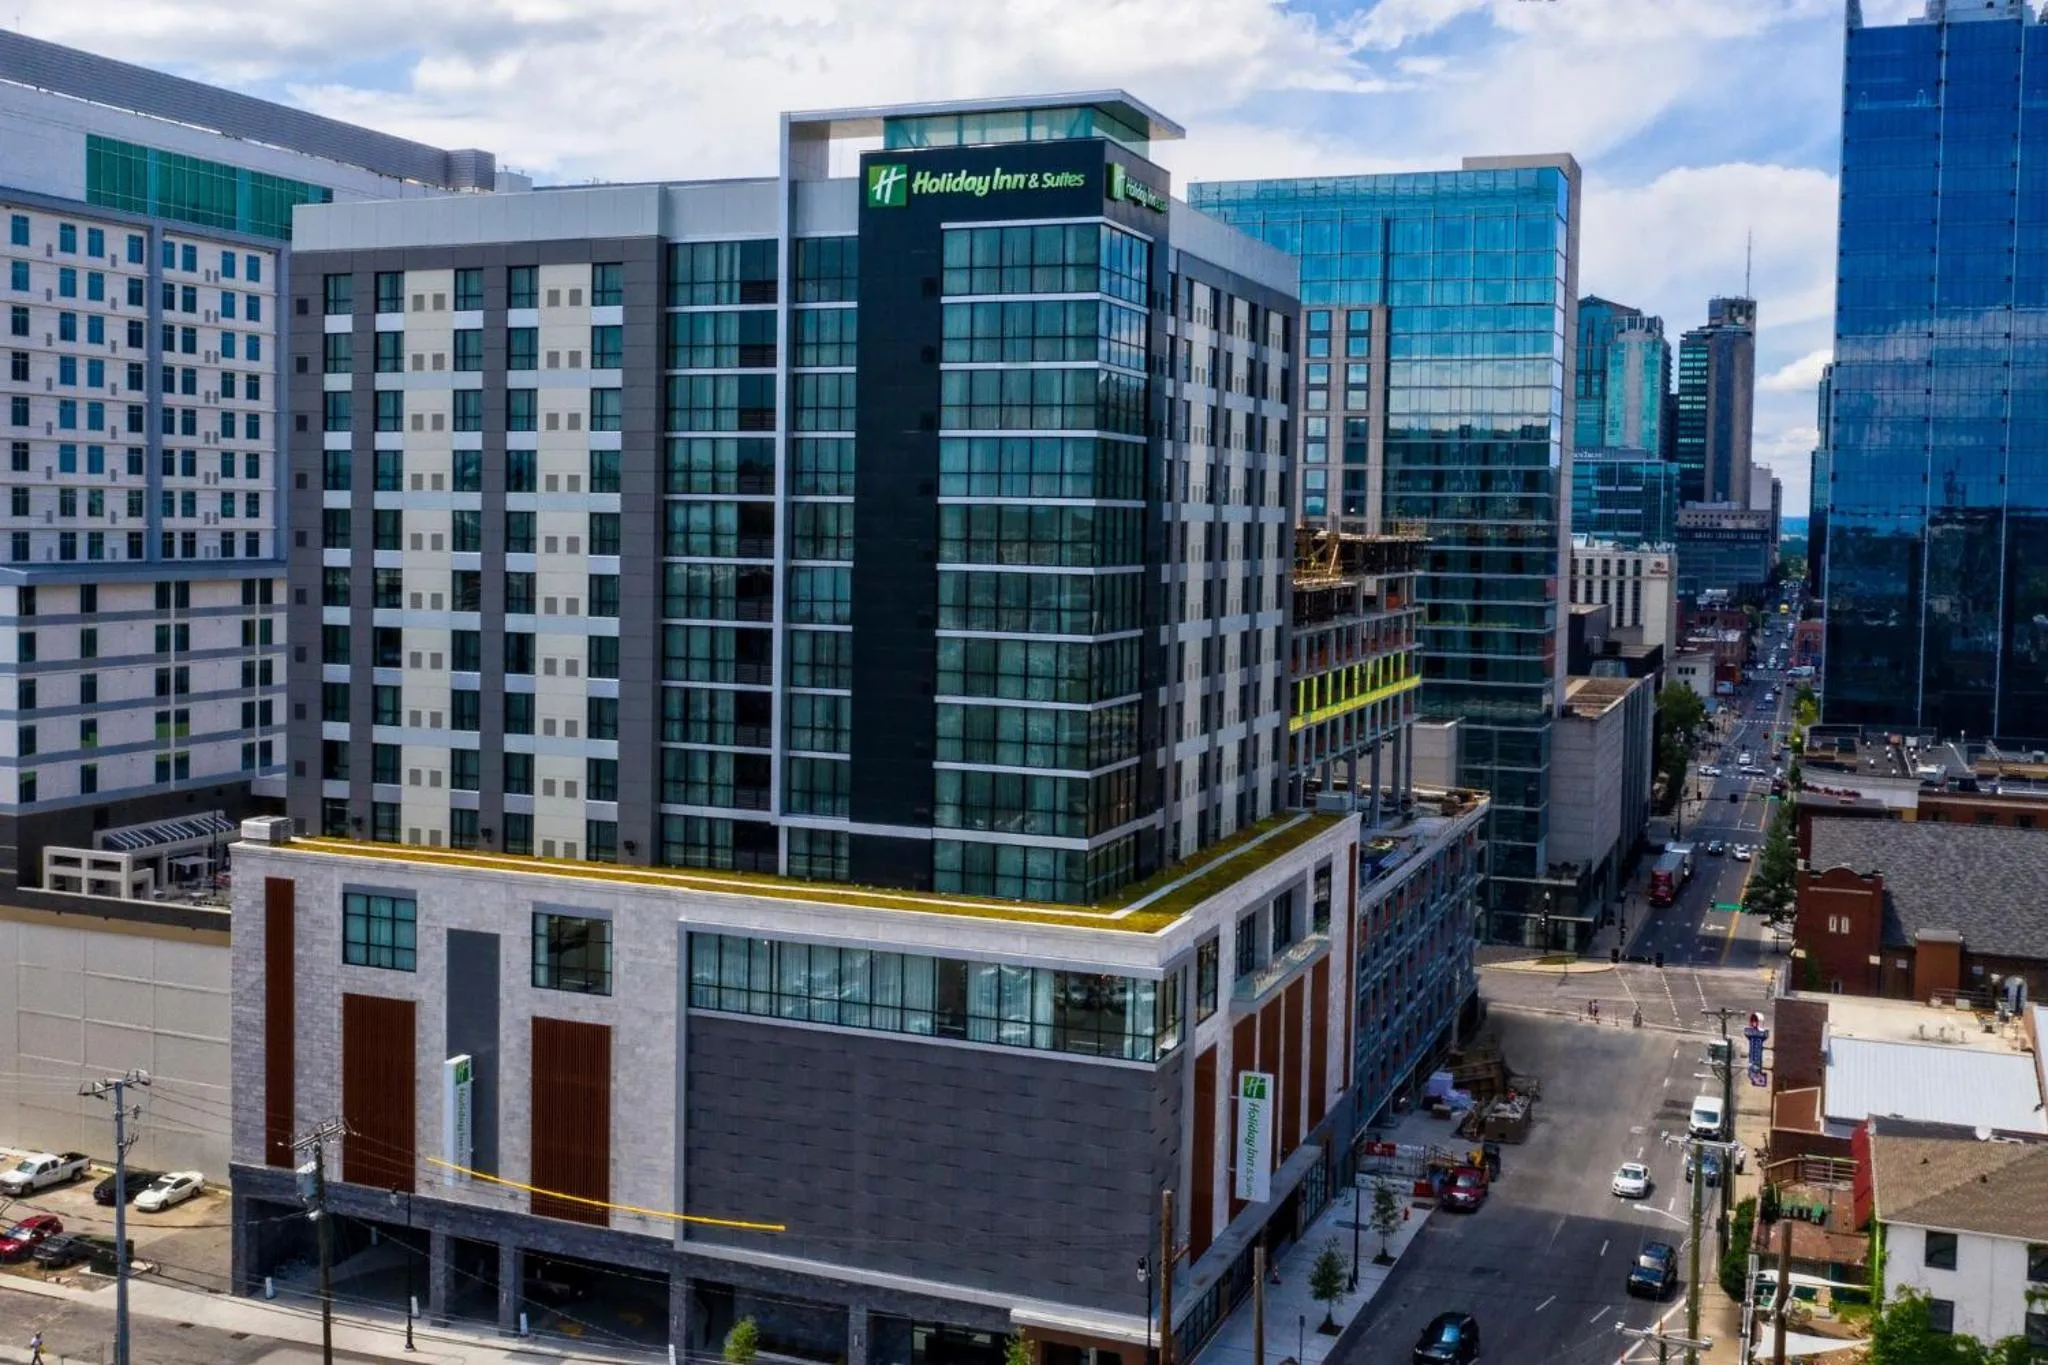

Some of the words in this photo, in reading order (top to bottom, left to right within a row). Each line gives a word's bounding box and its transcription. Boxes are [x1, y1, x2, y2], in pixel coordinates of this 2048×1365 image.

[912, 169, 990, 196] Holiday
[992, 167, 1027, 190] Inn
[1029, 175, 1039, 188] &
[1042, 171, 1085, 188] Suites
[1244, 1102, 1260, 1146] Holiday
[1246, 1147, 1259, 1166] Inn
